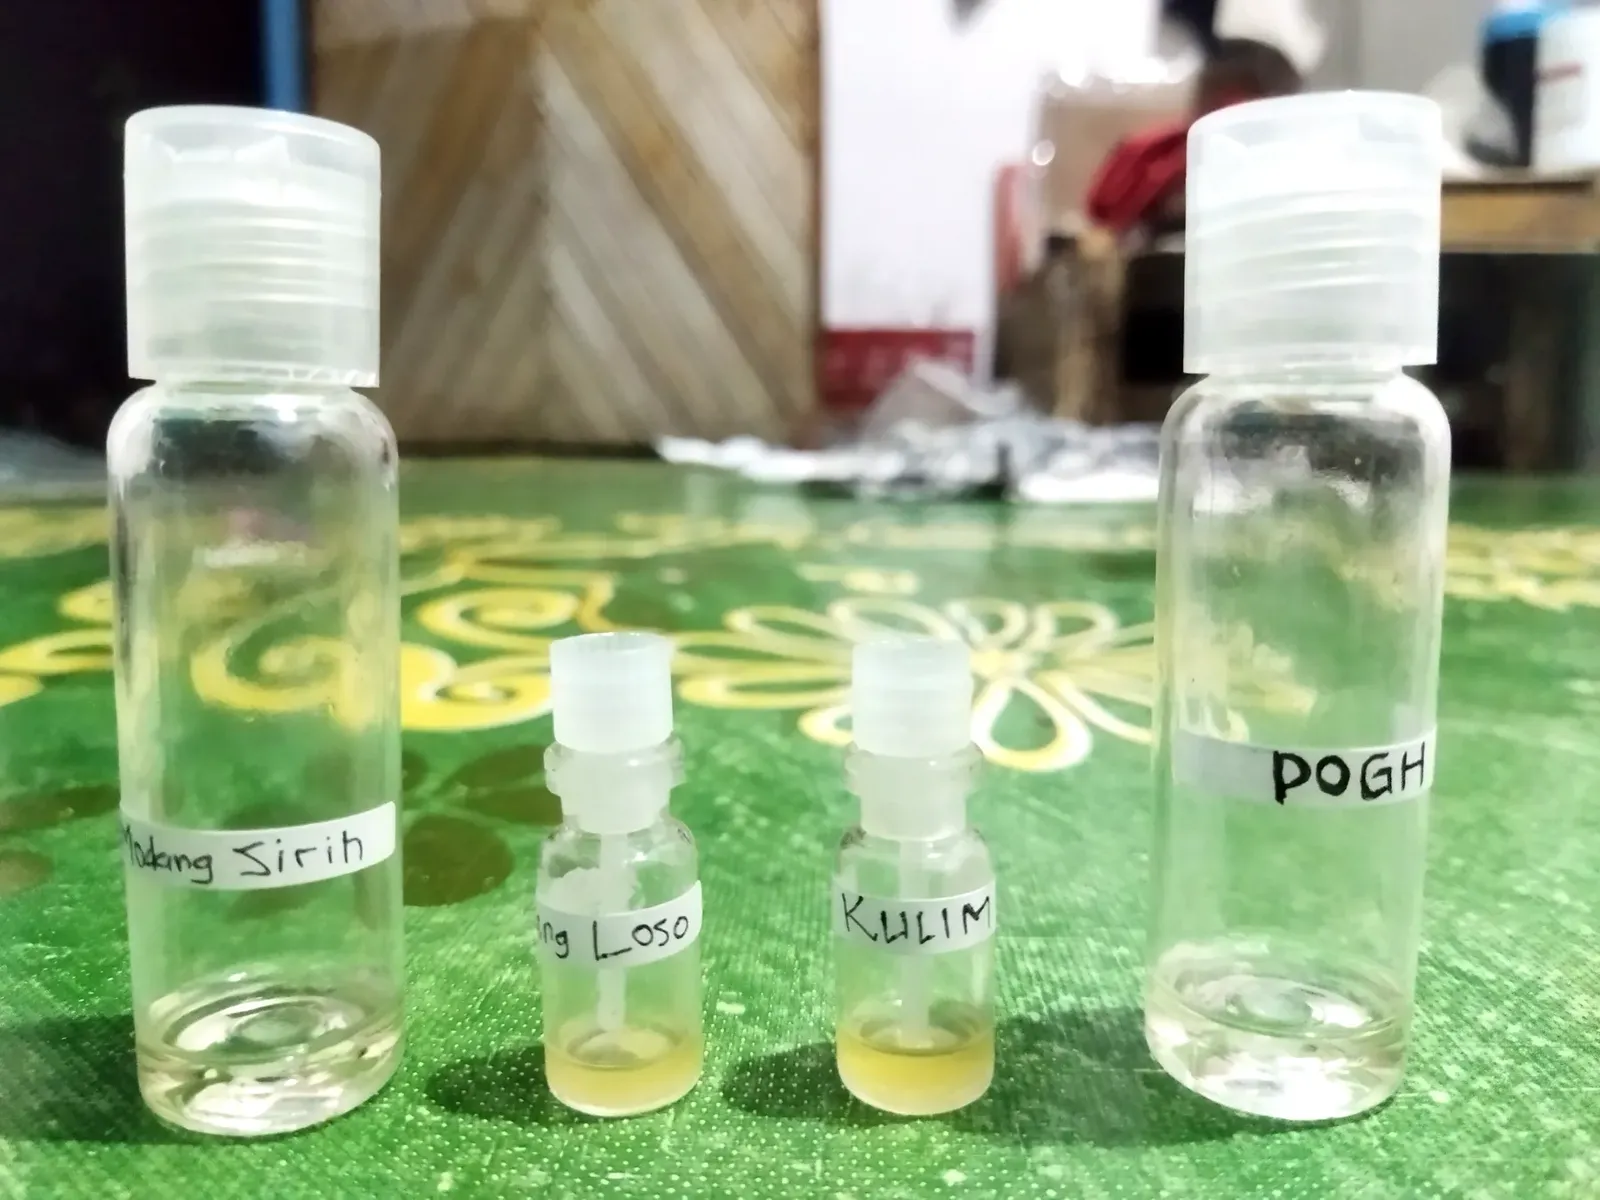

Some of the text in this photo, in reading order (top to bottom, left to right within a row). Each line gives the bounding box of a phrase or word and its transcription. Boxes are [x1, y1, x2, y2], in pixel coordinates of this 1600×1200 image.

[1273, 741, 1425, 805] POGH
[232, 831, 363, 876] Sirih
[842, 893, 991, 944] KULIM
